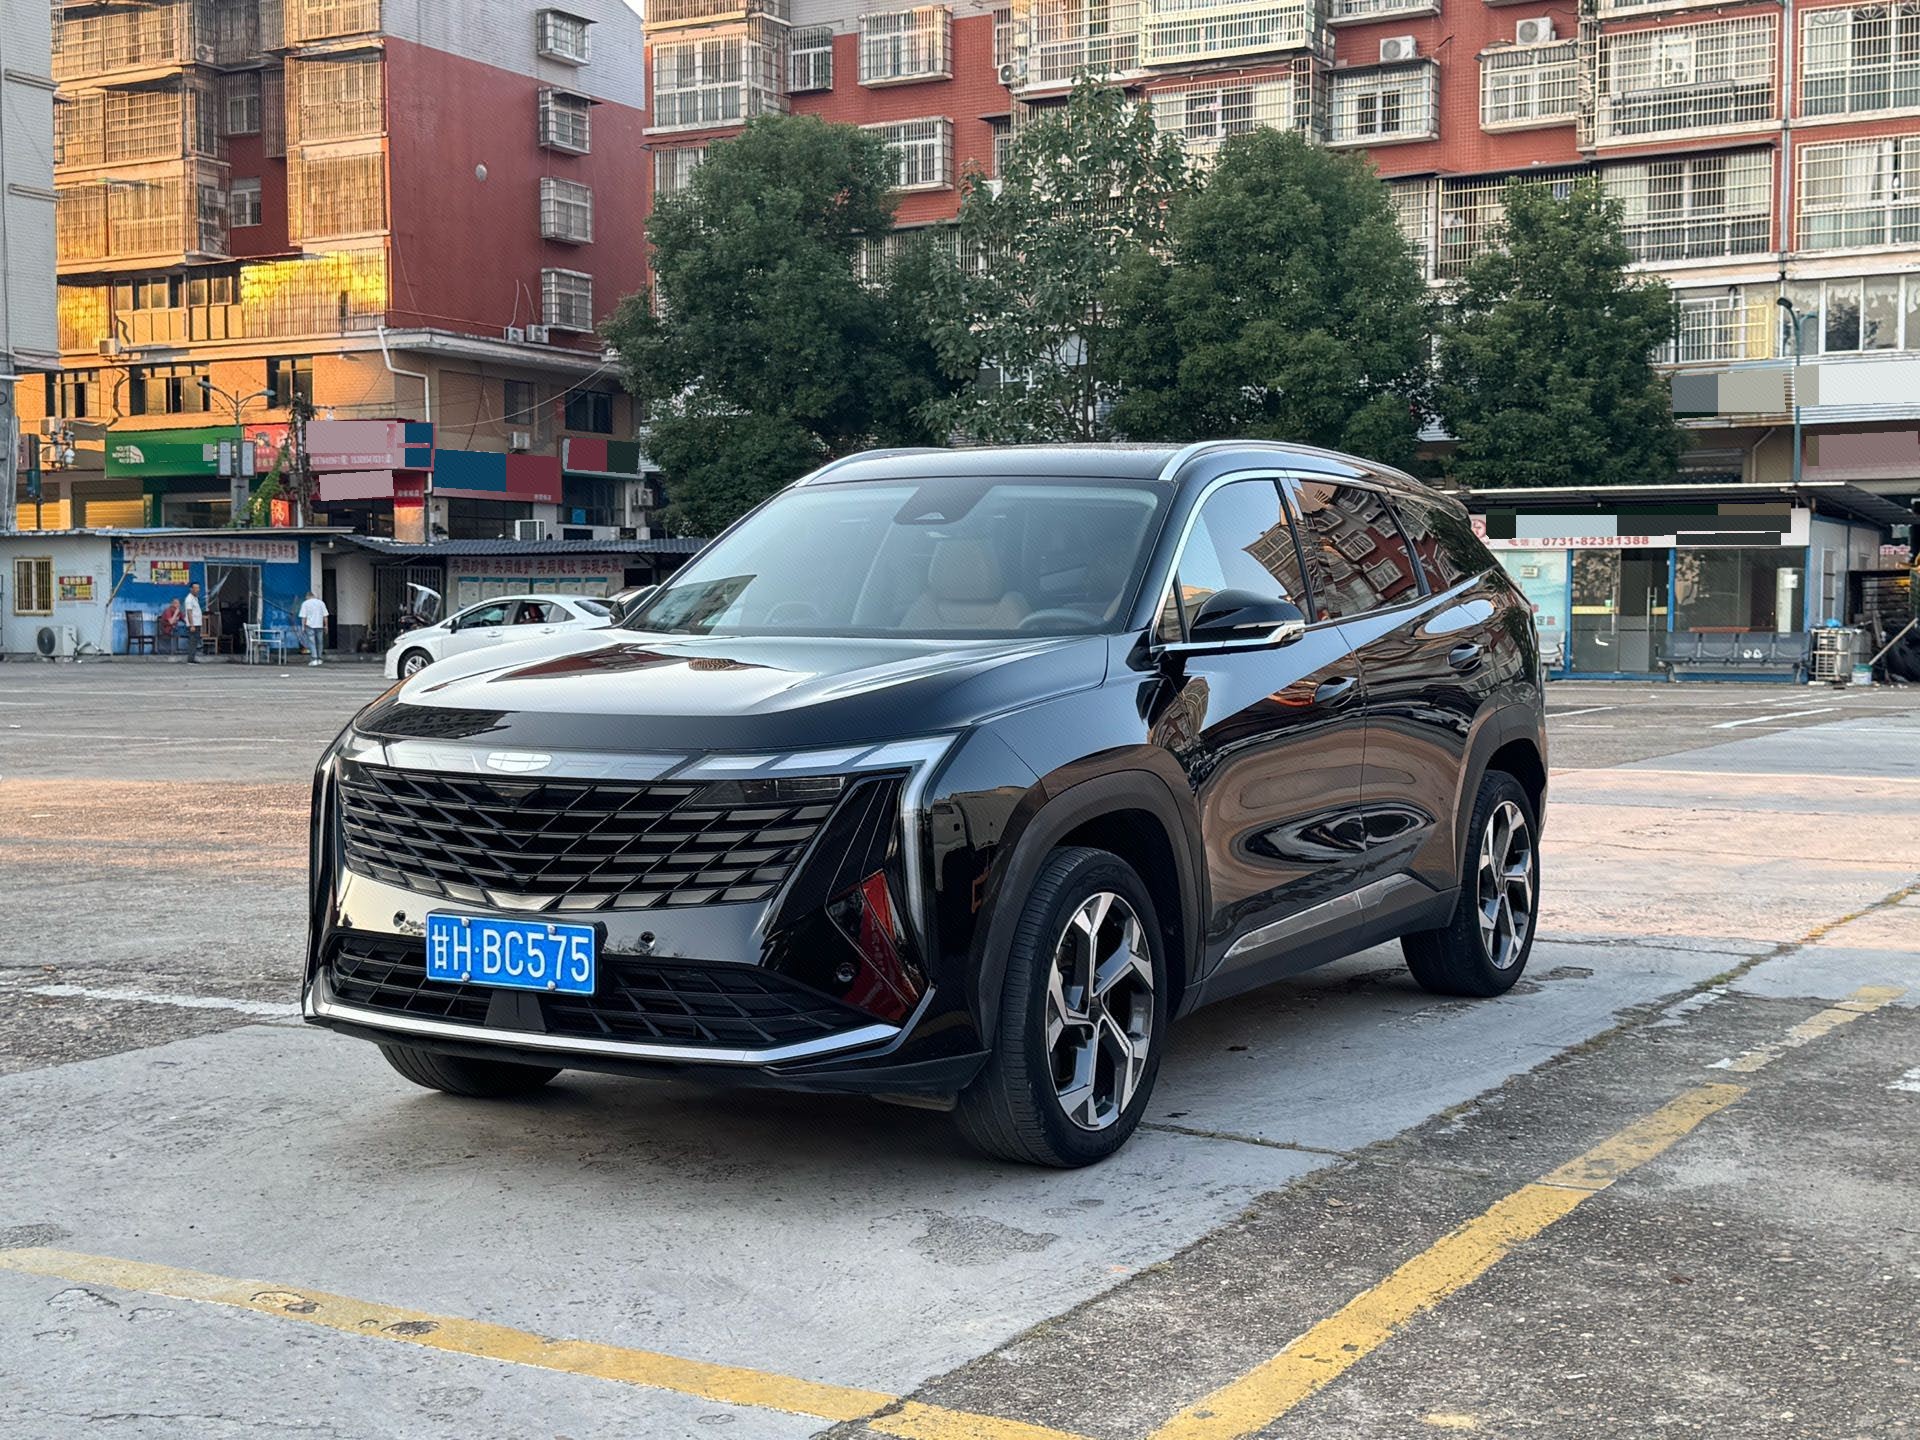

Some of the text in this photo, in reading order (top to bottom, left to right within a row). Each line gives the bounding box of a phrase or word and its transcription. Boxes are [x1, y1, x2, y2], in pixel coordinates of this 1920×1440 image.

[1542, 536, 1650, 547] 0731-82391388
[536, 559, 577, 574] 共同建设
